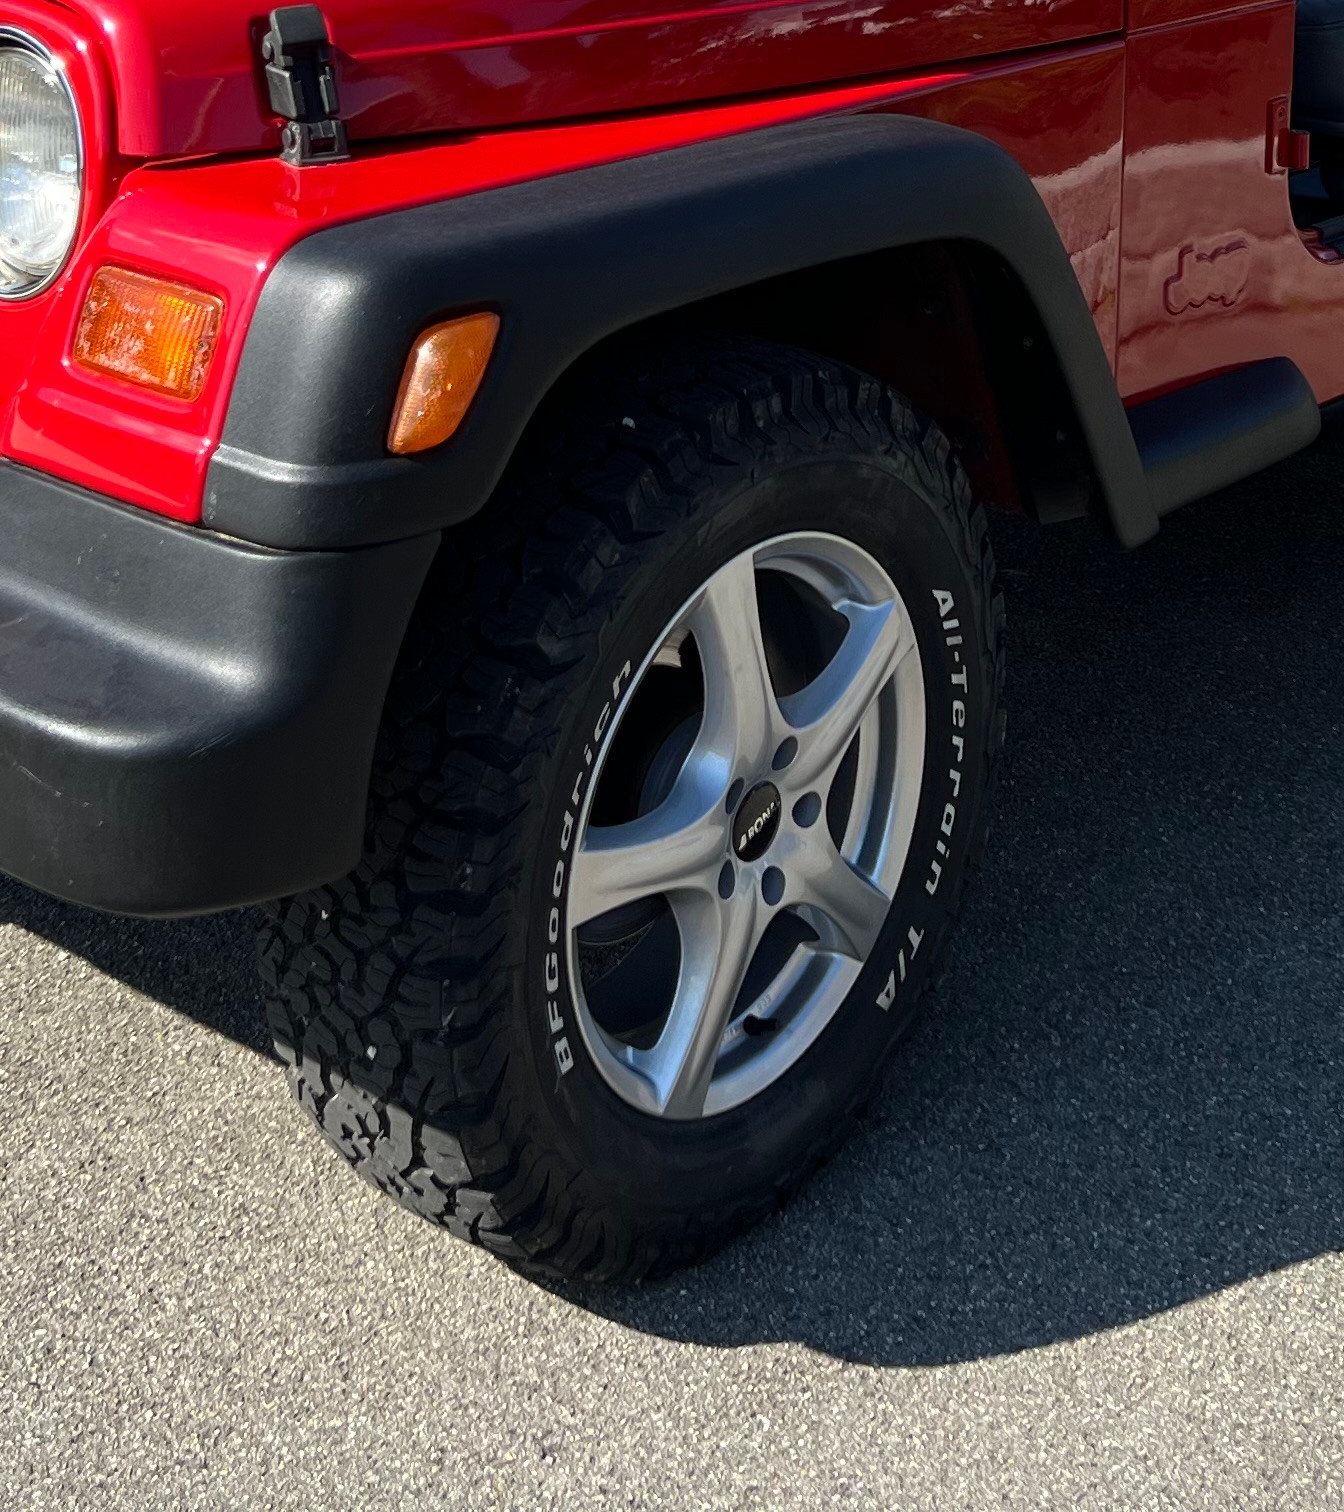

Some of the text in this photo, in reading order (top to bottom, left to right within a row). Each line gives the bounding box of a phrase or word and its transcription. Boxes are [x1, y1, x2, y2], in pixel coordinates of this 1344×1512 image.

[545, 659, 632, 1076] BFGoodrich
[875, 589, 968, 1012] All-Terrain T/A
